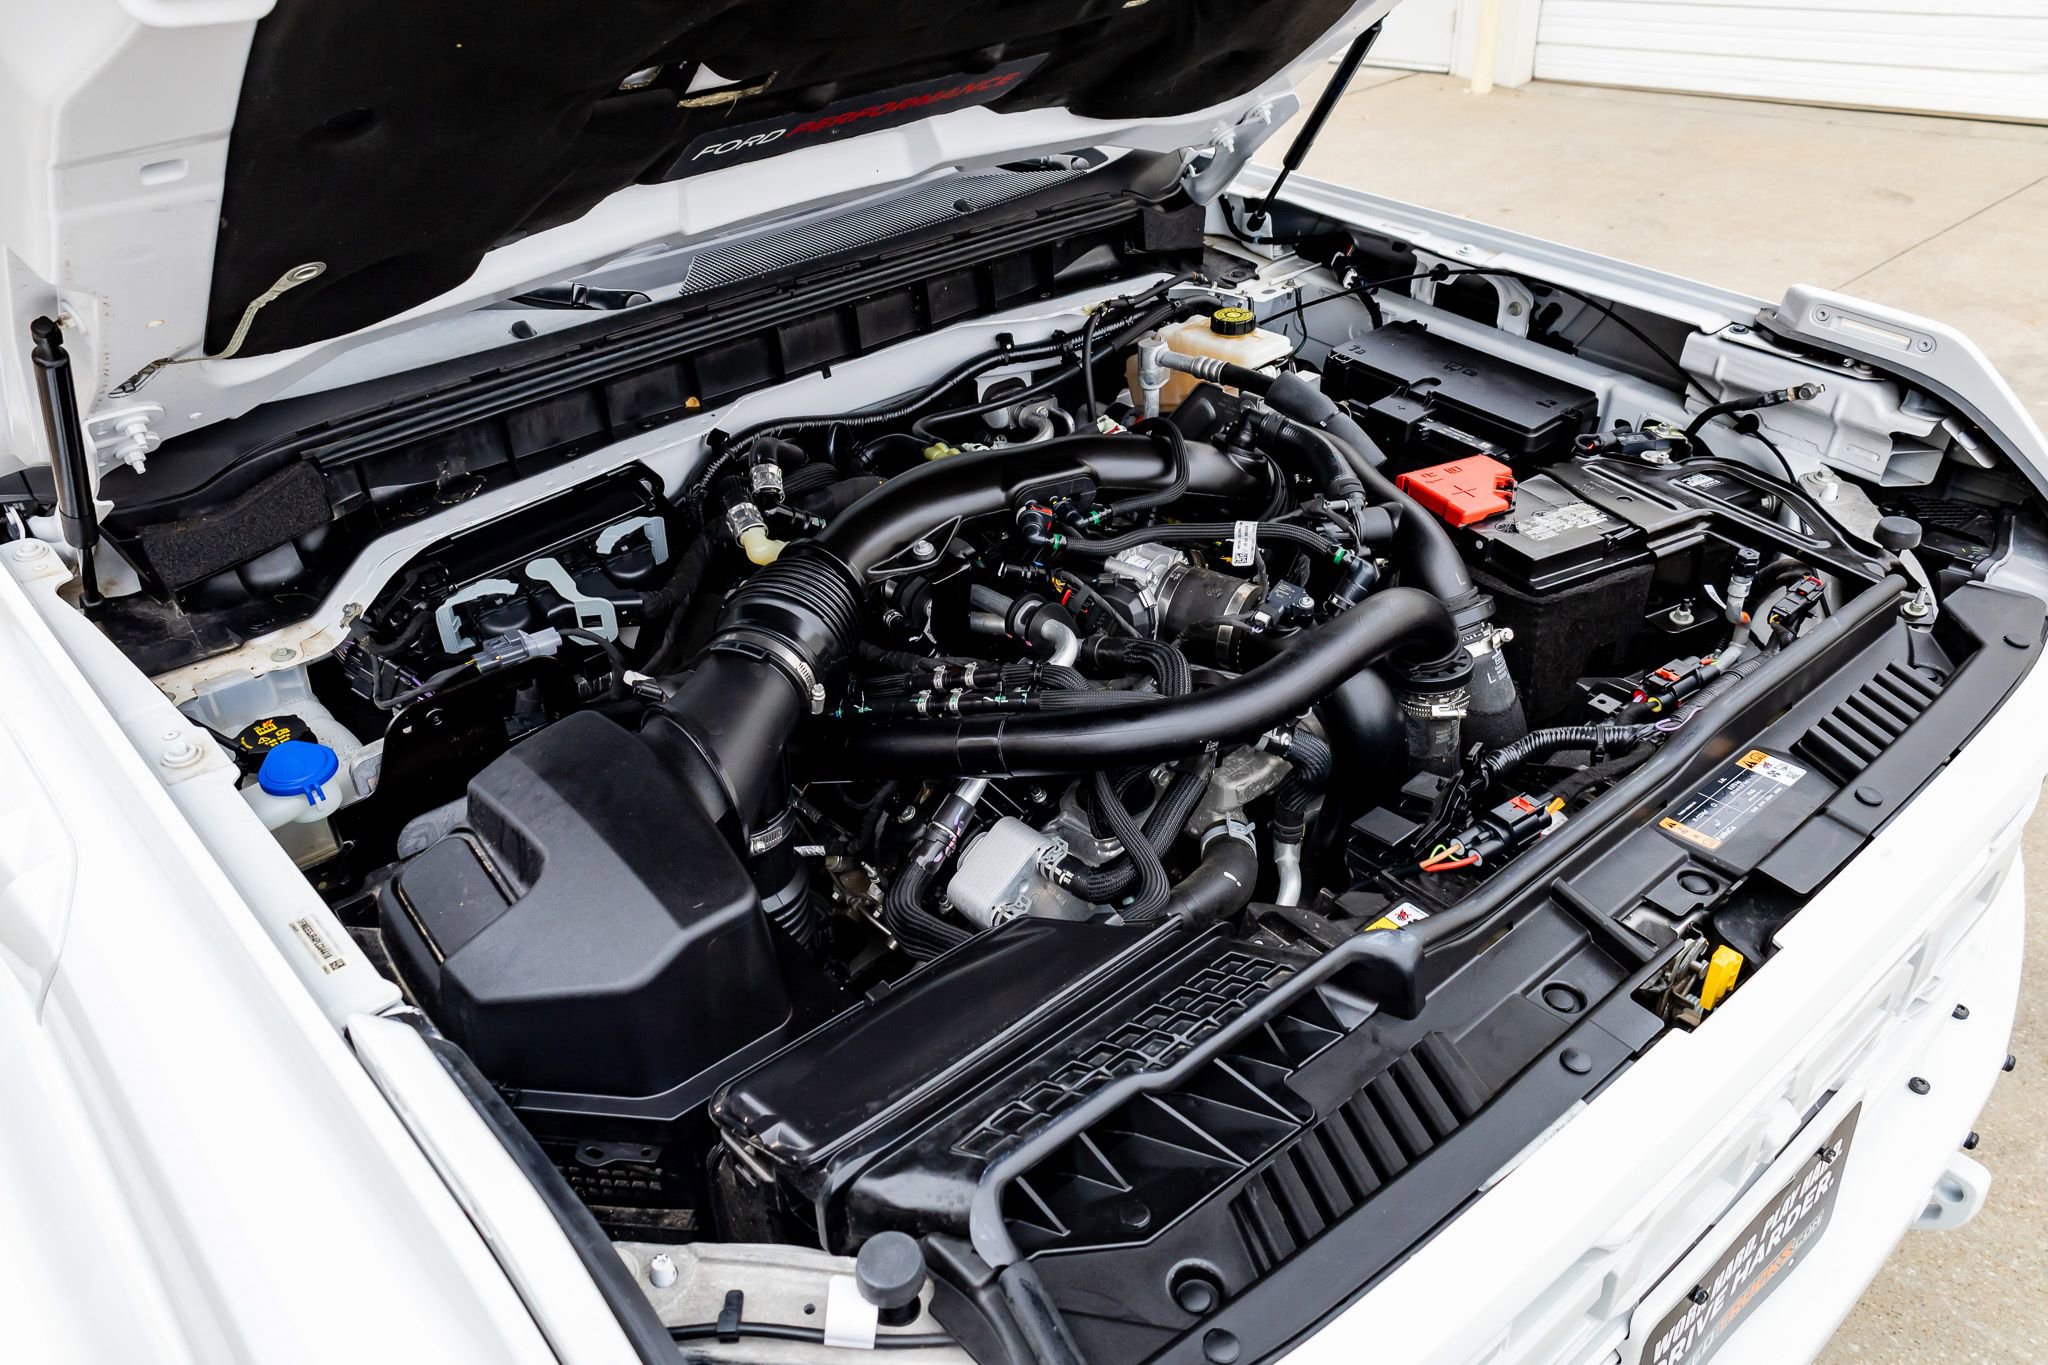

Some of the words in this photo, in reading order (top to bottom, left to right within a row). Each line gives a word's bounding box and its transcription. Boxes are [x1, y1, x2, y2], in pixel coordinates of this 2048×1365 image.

[691, 127, 787, 161] FORD
[786, 71, 1022, 137] PERFORMANCE
[1760, 1184, 1802, 1245] PLAY
[1657, 1283, 1729, 1365] RIVE
[1729, 1170, 1835, 1297] HARDER.
